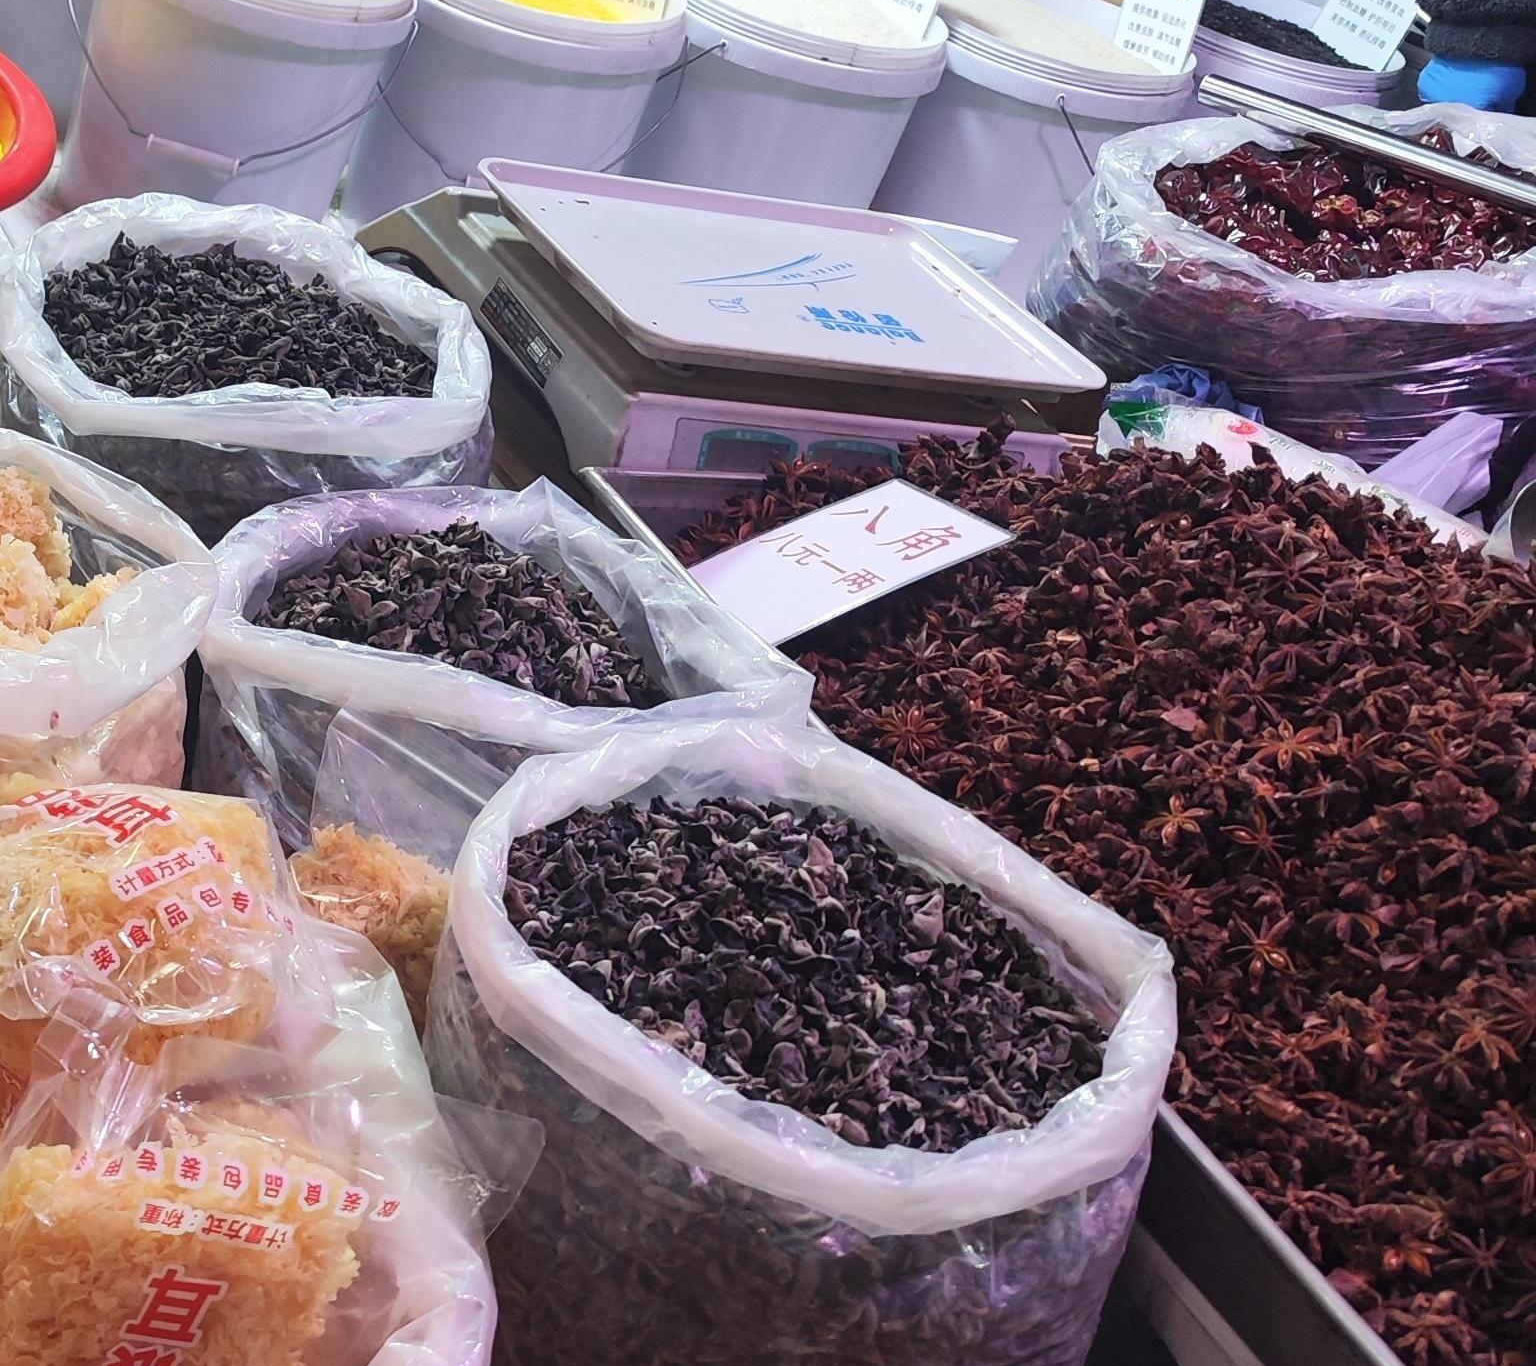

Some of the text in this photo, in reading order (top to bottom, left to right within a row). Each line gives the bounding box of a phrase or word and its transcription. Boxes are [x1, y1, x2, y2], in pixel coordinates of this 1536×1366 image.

[829, 504, 963, 562] 八角
[758, 532, 886, 595] 八元一两
